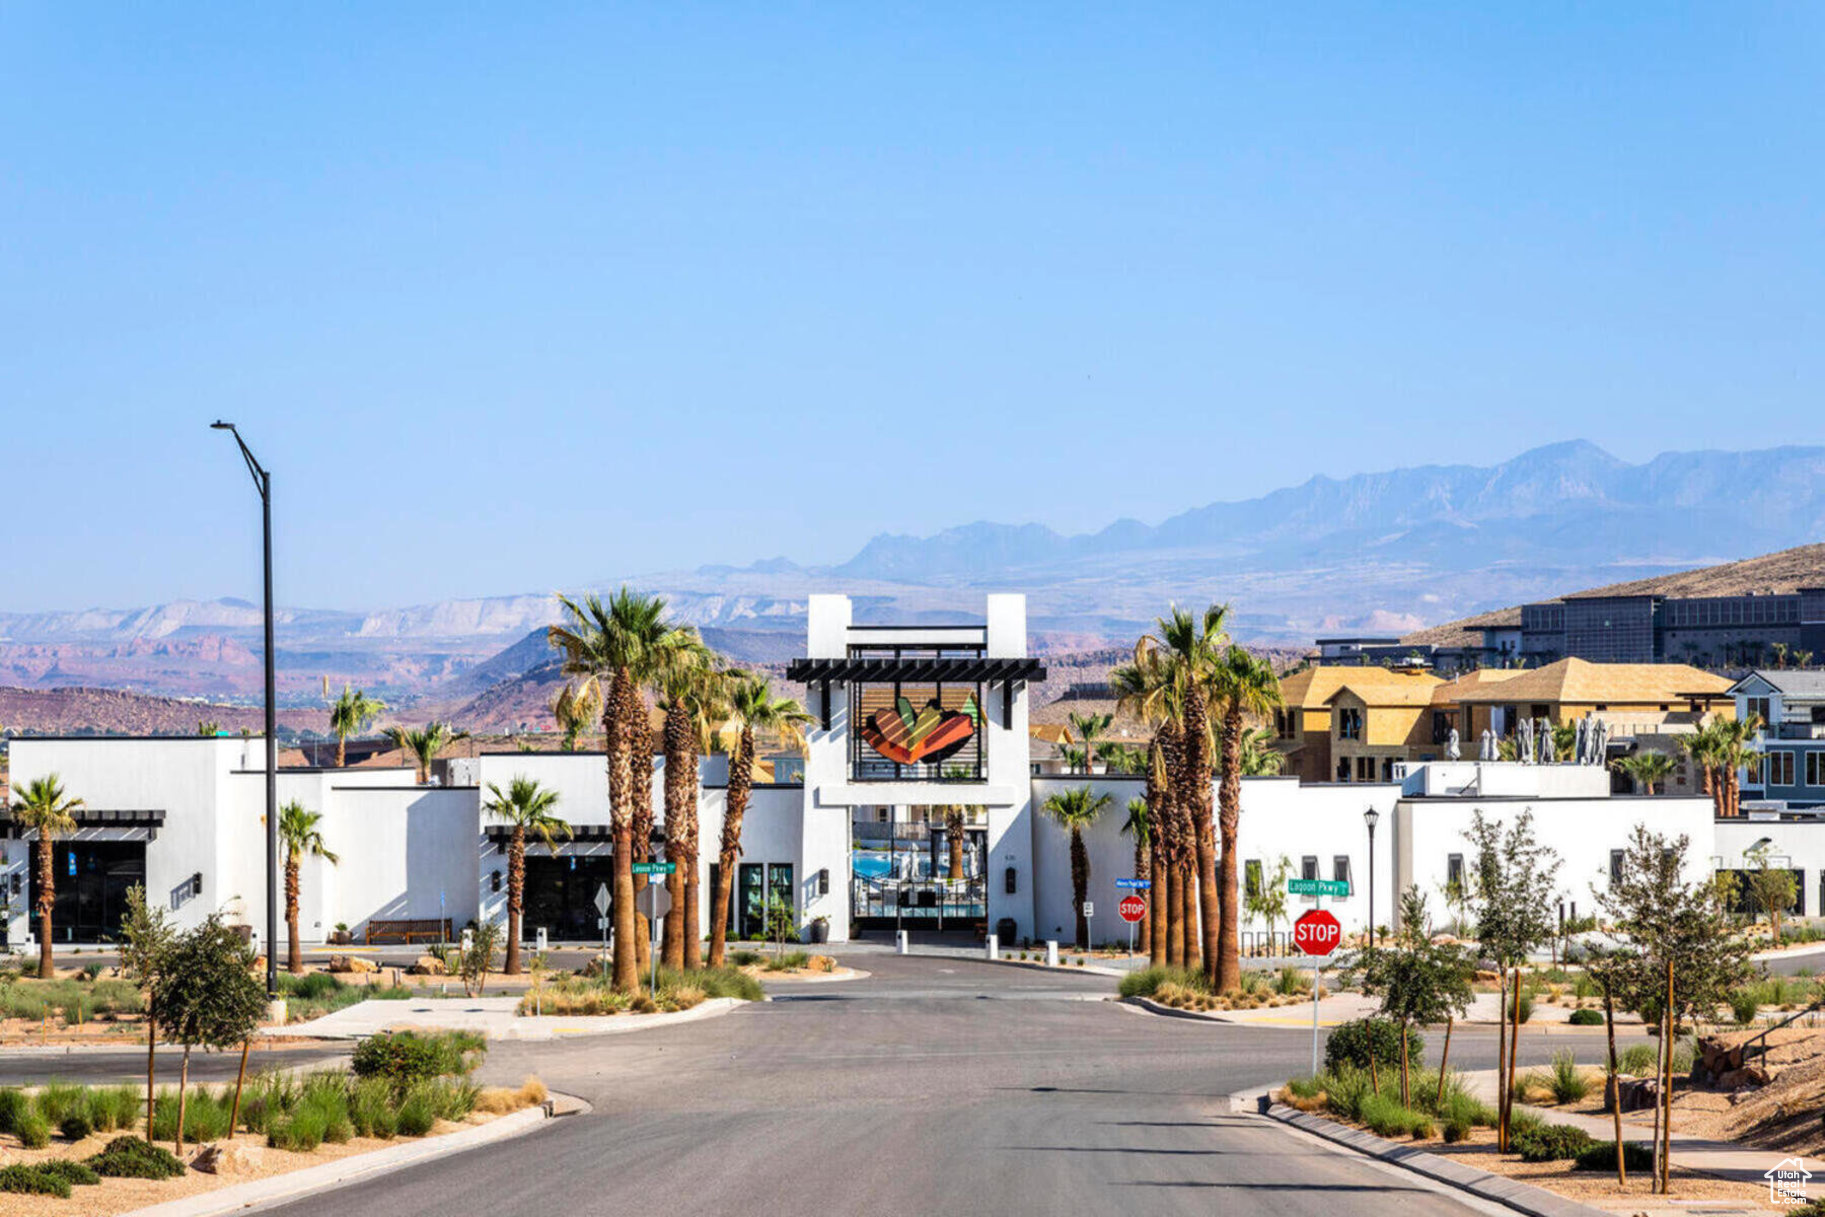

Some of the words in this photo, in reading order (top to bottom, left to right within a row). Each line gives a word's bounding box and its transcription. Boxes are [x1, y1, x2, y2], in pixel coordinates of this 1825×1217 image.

[1290, 881, 1316, 893] Lagoon
[1318, 882, 1338, 894] Pkwy
[1120, 903, 1145, 915] STOP
[1297, 923, 1339, 942] STOP
